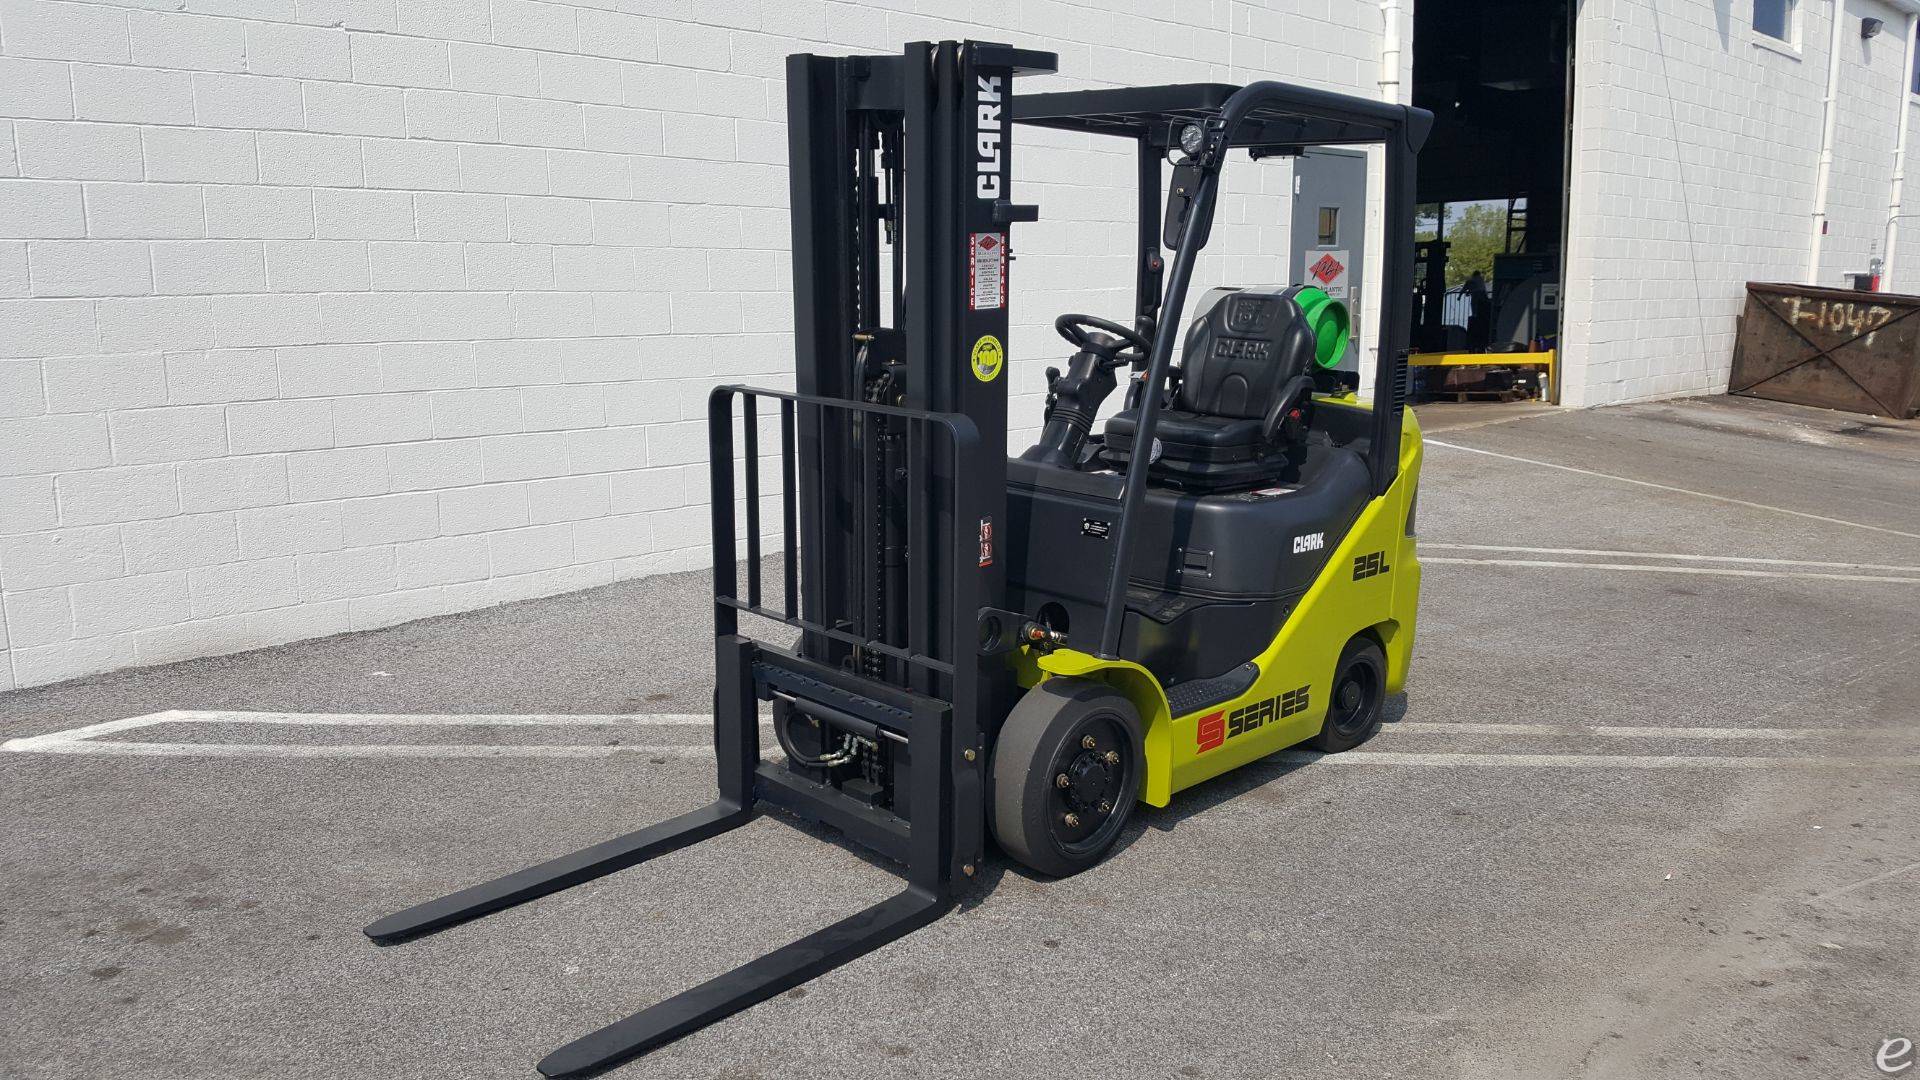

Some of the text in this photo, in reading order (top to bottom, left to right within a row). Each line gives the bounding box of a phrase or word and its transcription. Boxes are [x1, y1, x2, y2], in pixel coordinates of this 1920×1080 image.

[977, 75, 1001, 199] CLARK
[1293, 532, 1324, 554] CLARK
[1352, 550, 1390, 581] 25L
[1196, 684, 1312, 755] S SERIES
